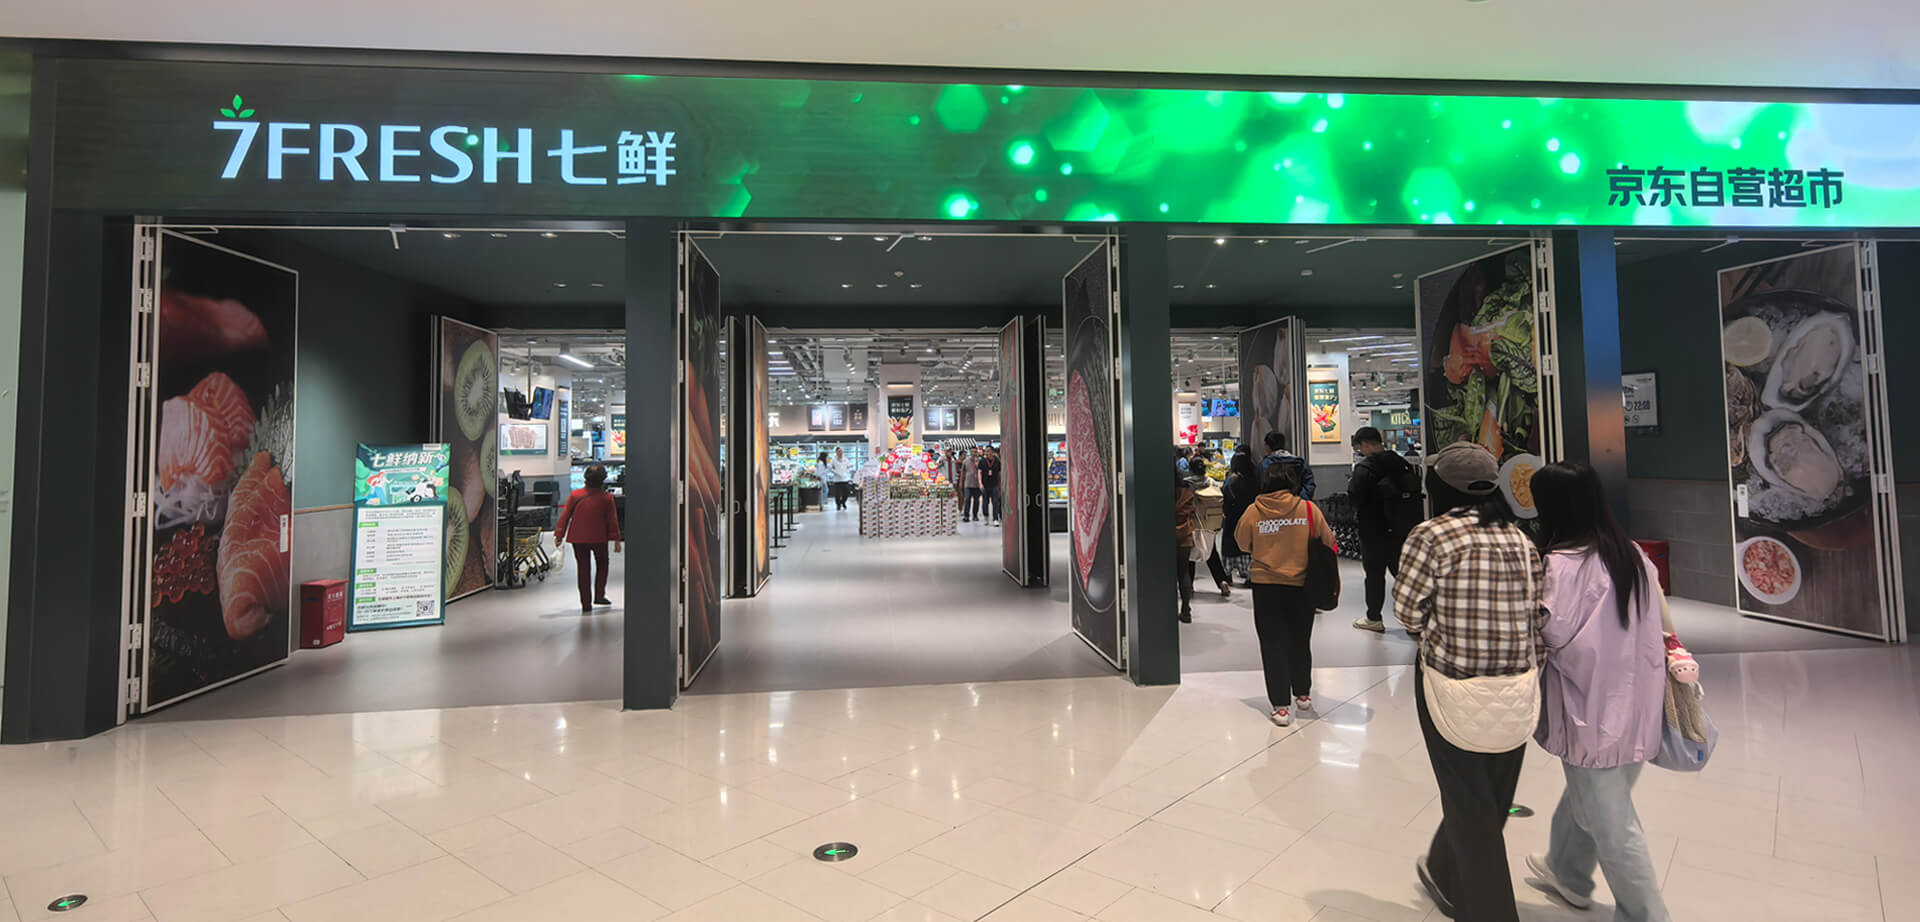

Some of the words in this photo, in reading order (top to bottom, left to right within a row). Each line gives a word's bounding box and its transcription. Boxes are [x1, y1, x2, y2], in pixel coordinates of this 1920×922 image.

[213, 120, 532, 184] 7FRESH
[547, 129, 677, 187] 七鲜
[1606, 165, 1845, 208] 京东自营超市
[369, 452, 435, 468] 七鲜纳新
